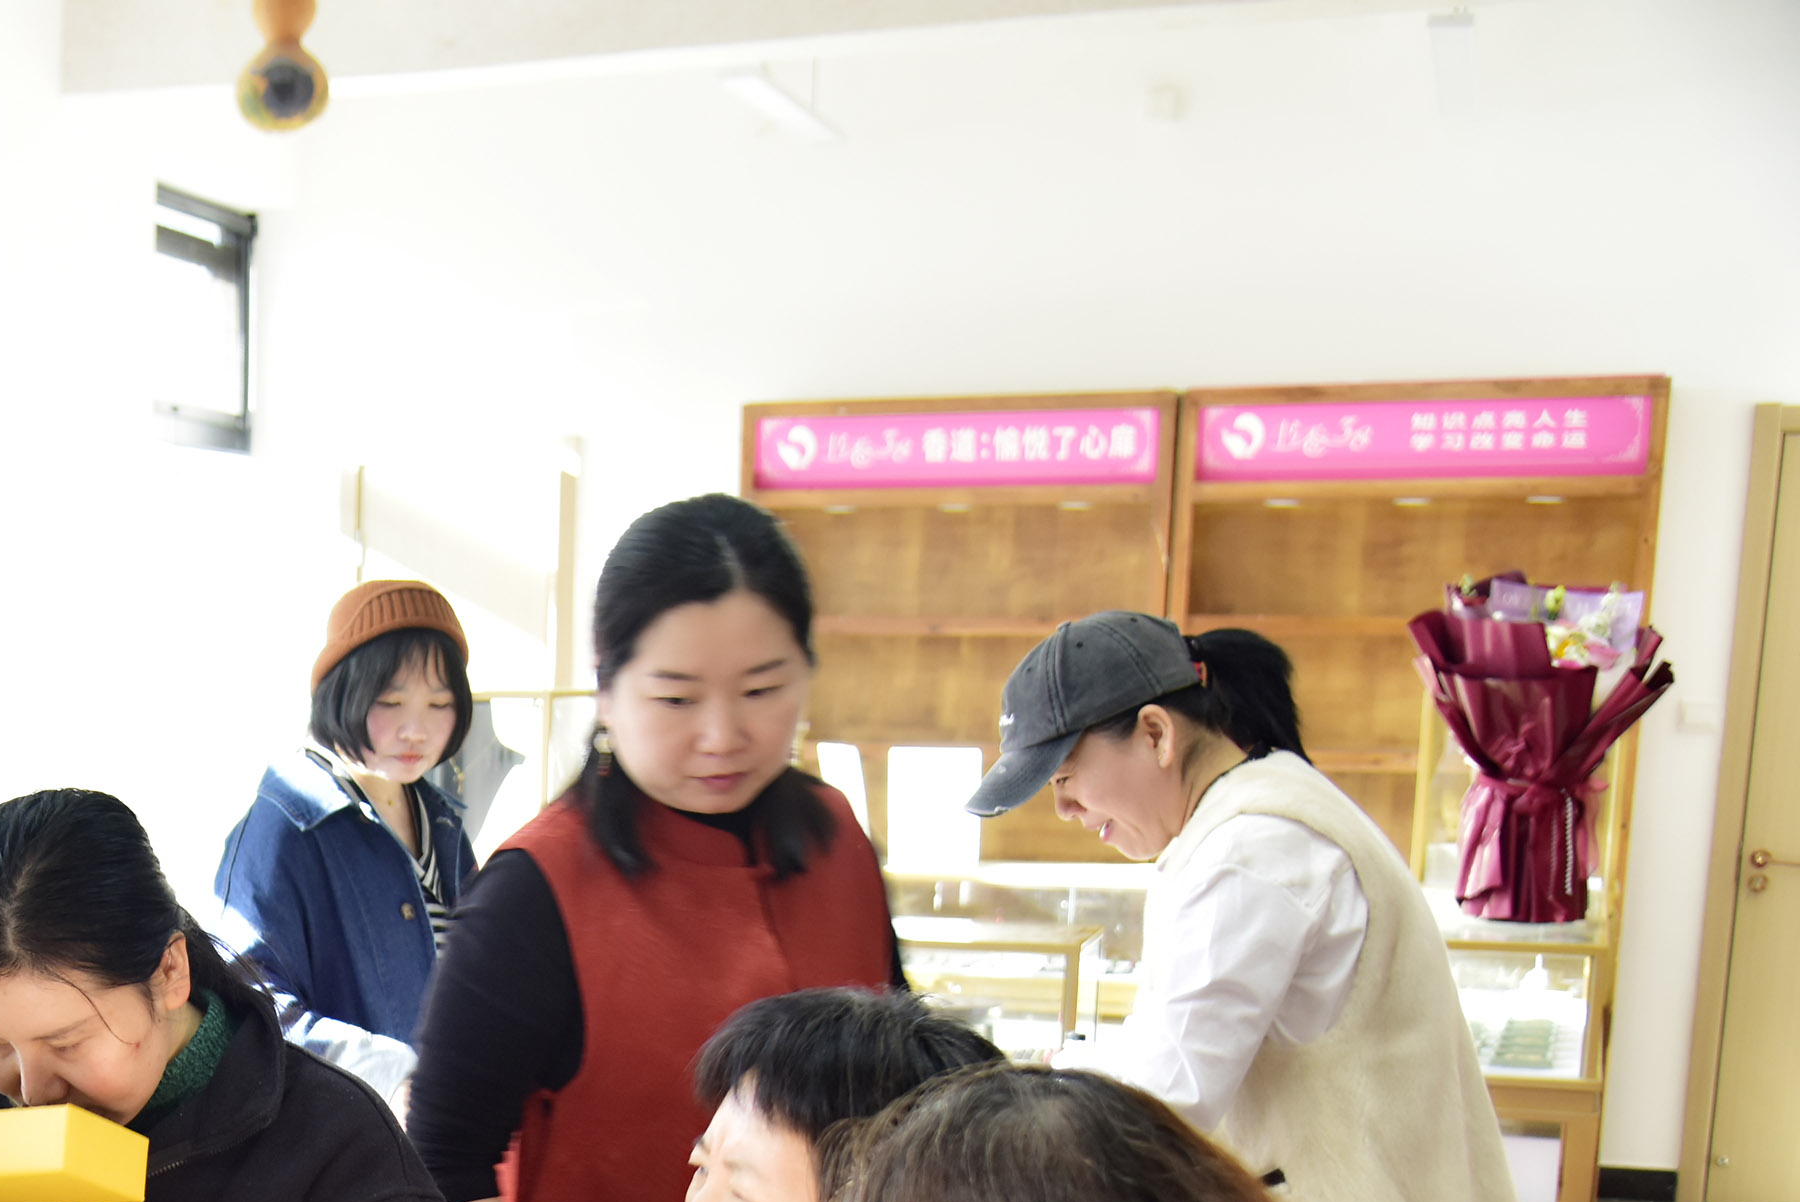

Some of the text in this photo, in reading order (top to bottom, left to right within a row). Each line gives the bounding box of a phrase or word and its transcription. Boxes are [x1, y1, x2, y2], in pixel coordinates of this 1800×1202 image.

[1409, 430, 1587, 452] 学习改变命运
